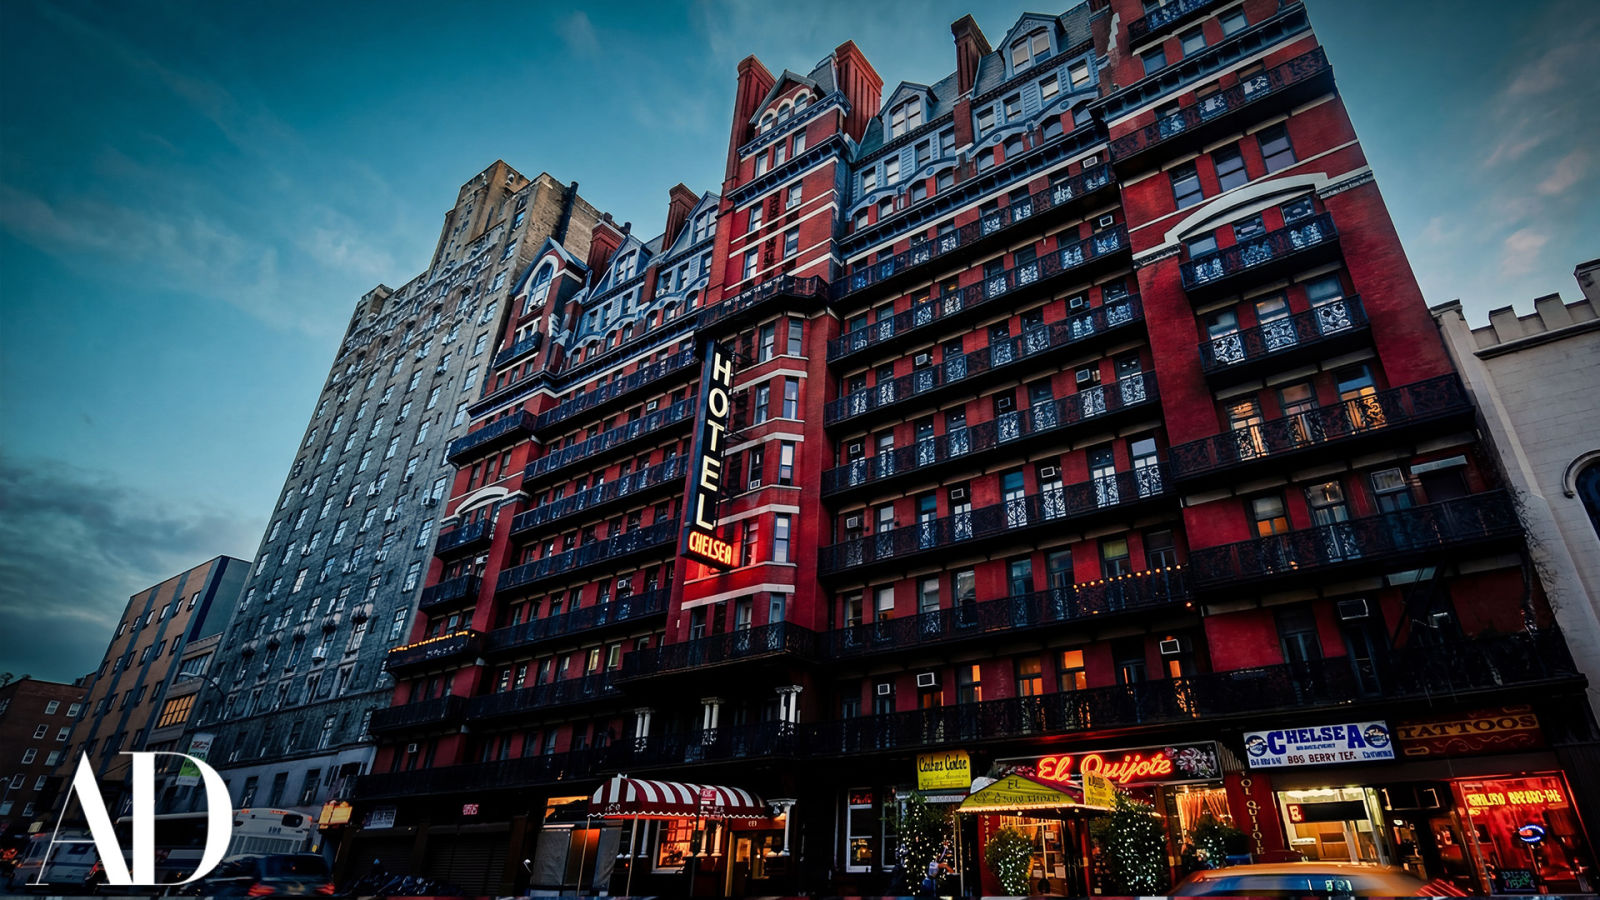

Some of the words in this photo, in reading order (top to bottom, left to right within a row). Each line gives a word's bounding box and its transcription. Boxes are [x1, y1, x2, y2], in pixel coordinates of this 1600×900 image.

[696, 353, 731, 531] HOTEL
[688, 531, 732, 565] CHELSEA
[1267, 725, 1366, 755] CHELSEA
[1399, 716, 1537, 738] TATTOOS
[1037, 756, 1070, 782] El
[1081, 754, 1171, 783] Quijote
